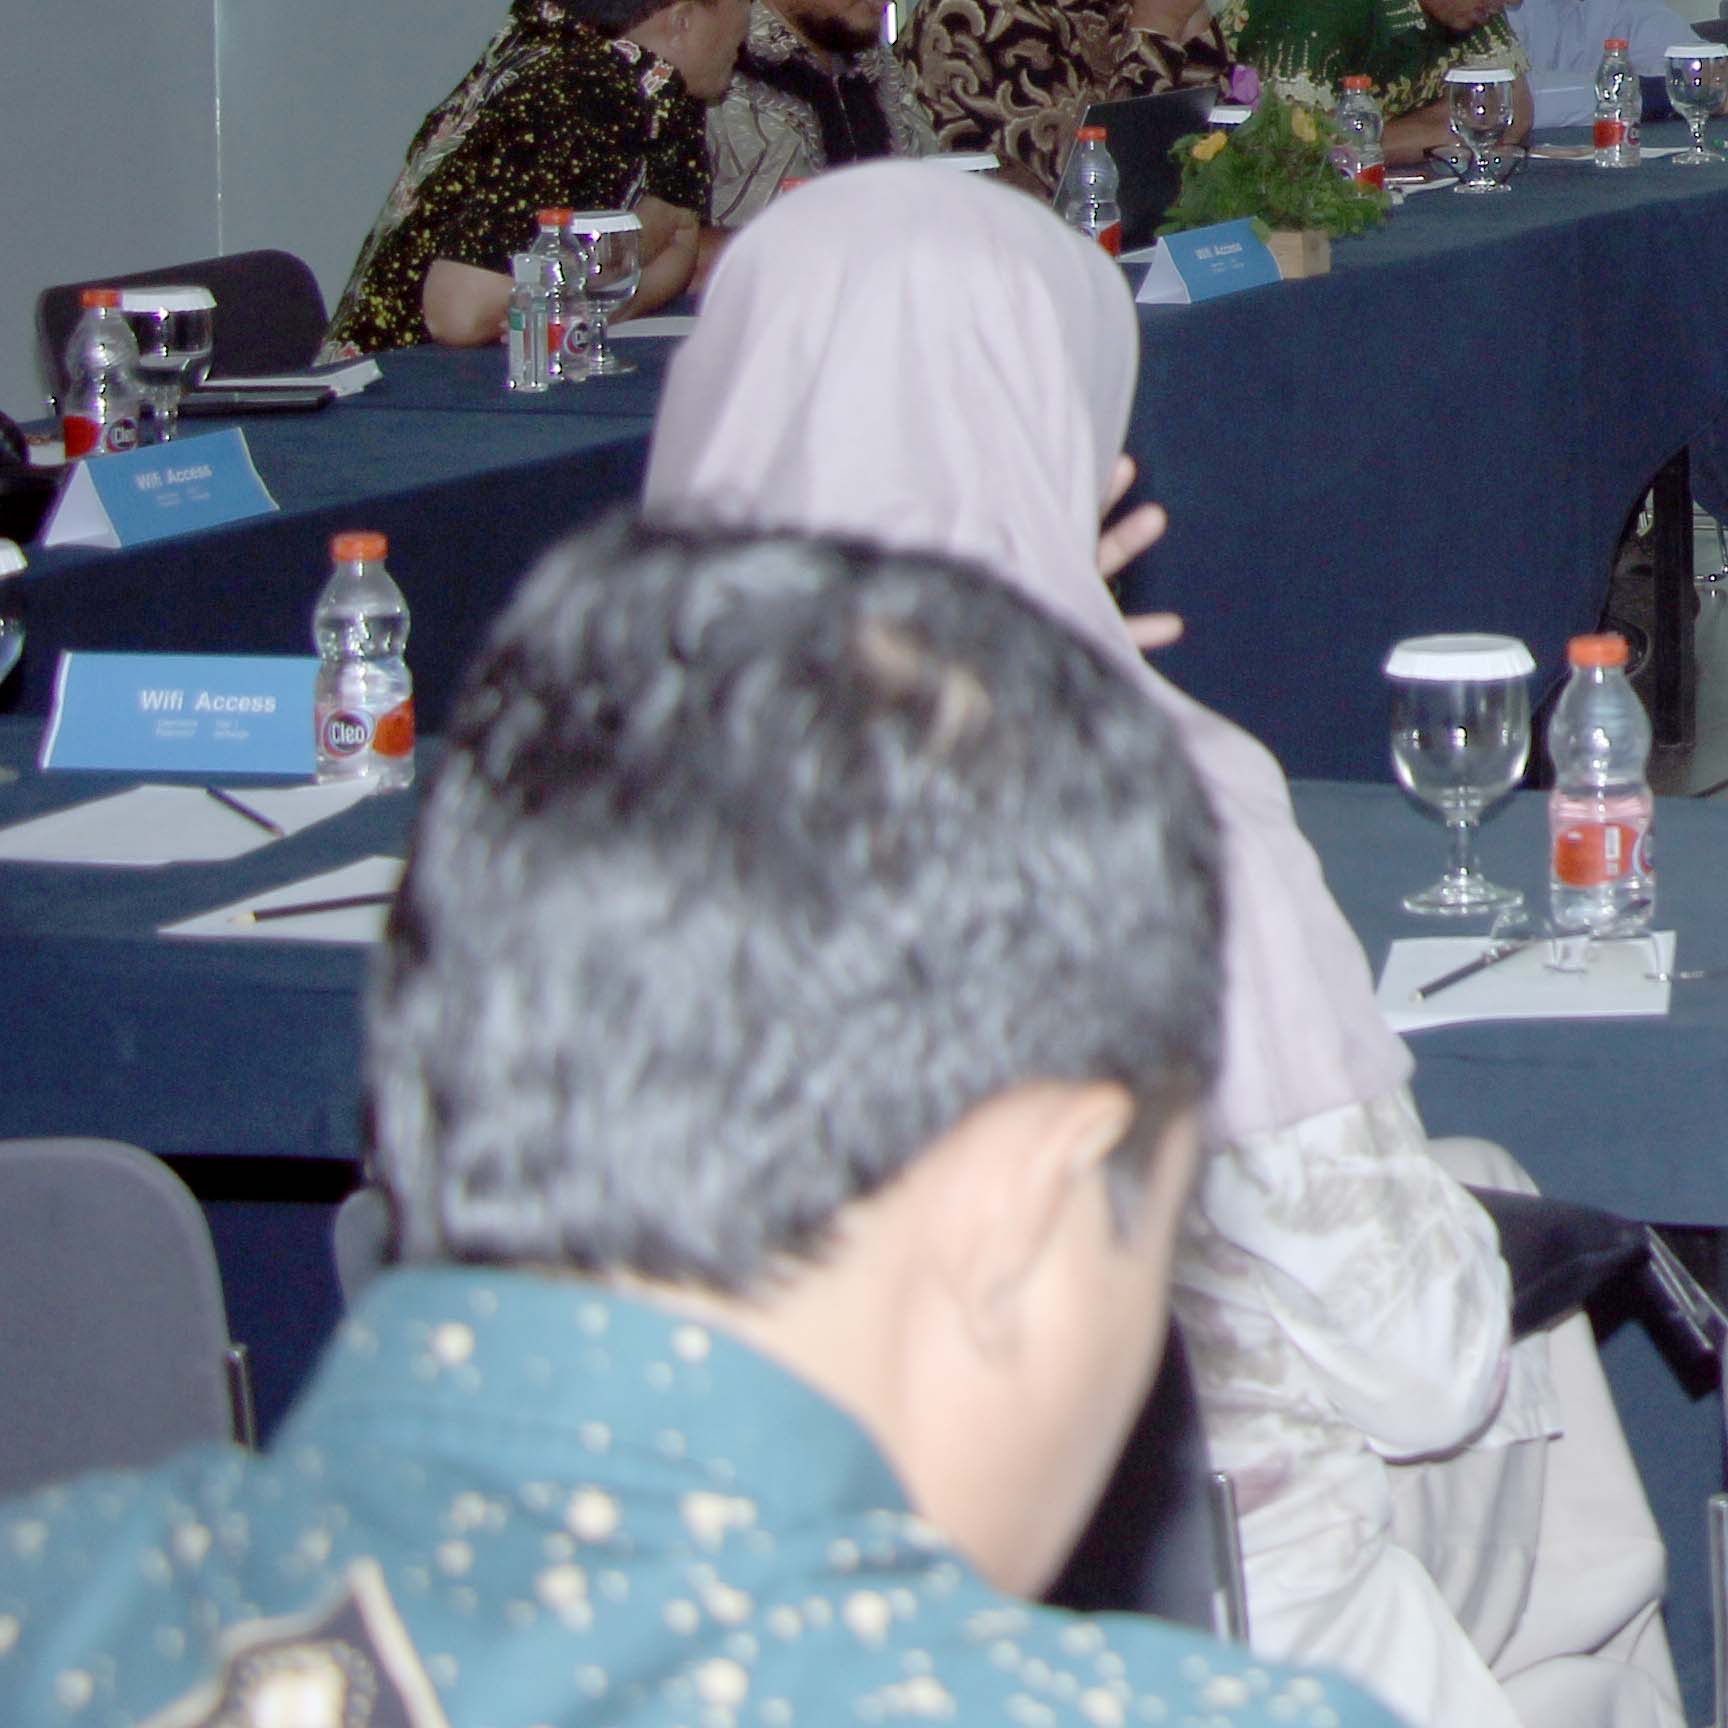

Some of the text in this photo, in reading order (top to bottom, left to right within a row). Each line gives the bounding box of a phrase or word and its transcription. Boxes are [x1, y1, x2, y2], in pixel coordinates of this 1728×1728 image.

[135, 464, 213, 491] Wifi Access
[140, 690, 277, 712] Wifi Access
[330, 722, 366, 744] Cleo
